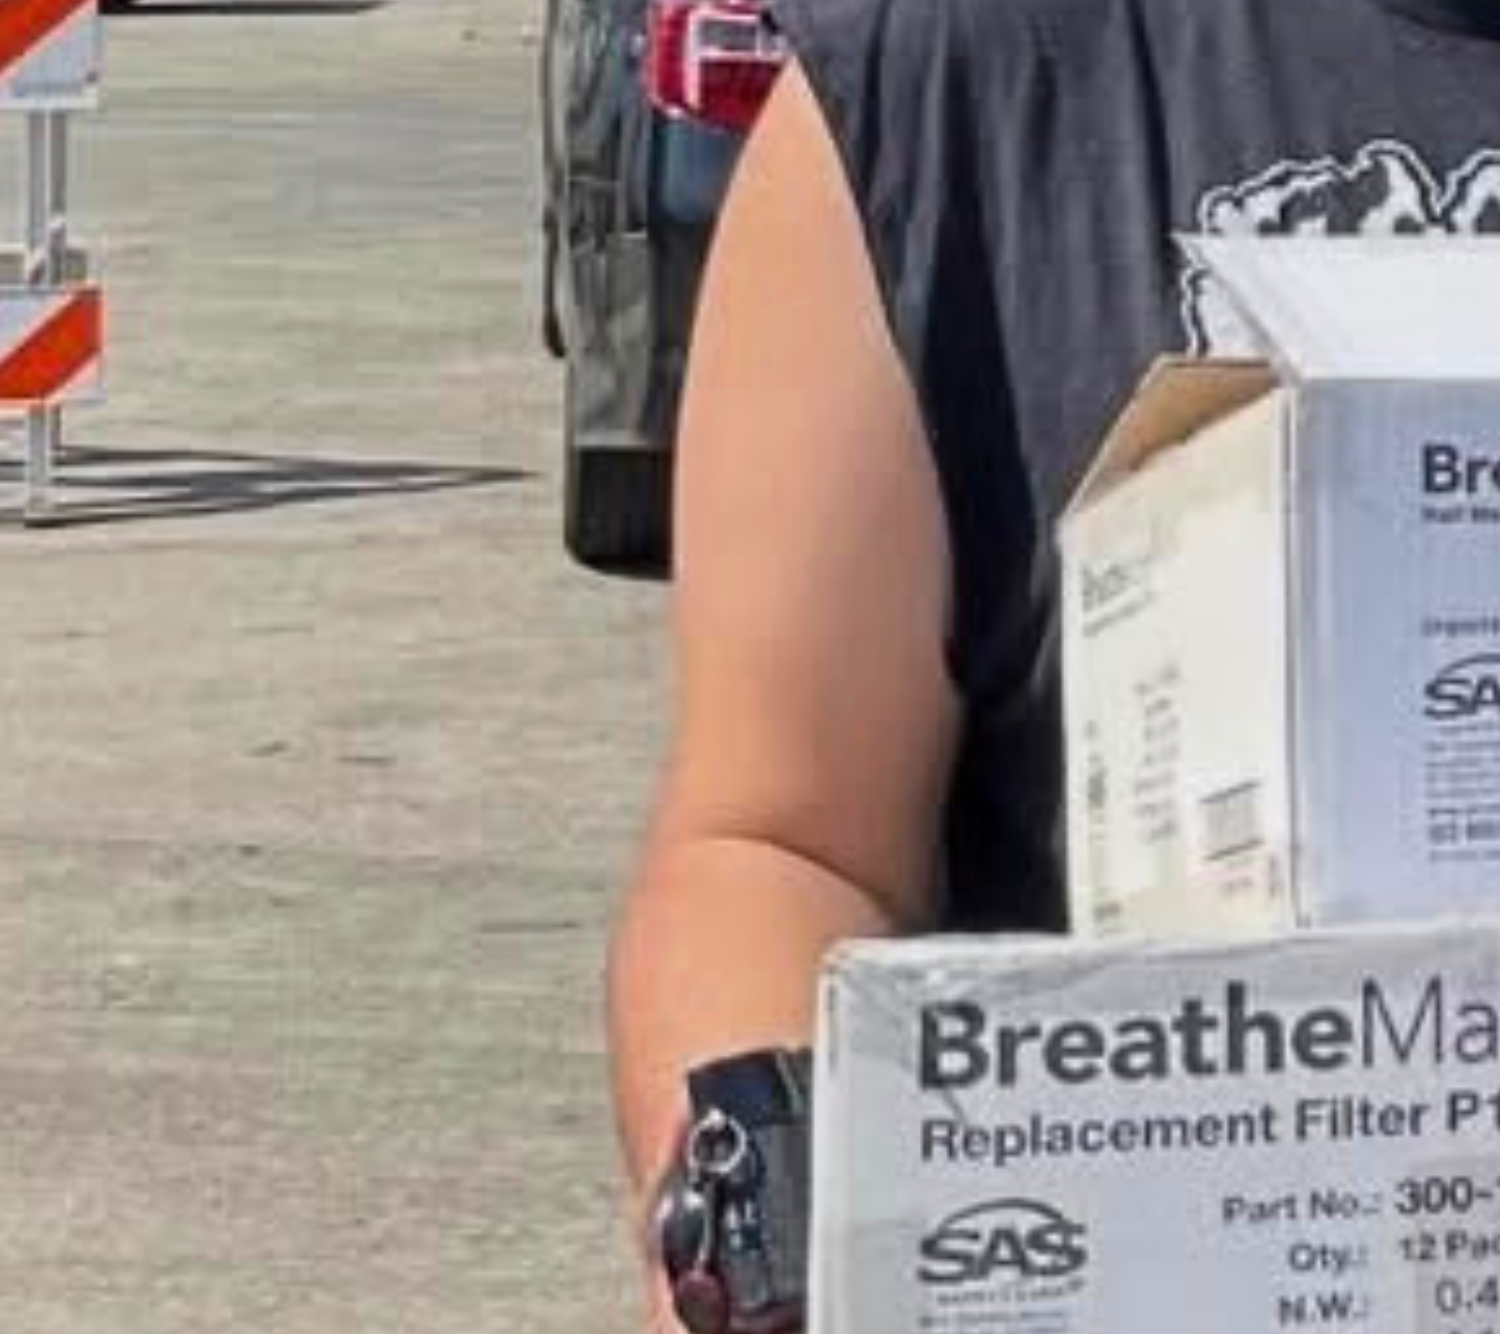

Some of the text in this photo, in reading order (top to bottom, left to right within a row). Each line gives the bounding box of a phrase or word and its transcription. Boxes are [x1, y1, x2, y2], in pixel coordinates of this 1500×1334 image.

[921, 1101, 1278, 1166] Replacement
[1296, 1097, 1430, 1141] Filter
[1222, 1192, 1297, 1226] Part
[917, 1207, 1088, 1286] SAS
[1401, 1233, 1437, 1263] 12
[1435, 1277, 1500, 1314] 0.4
